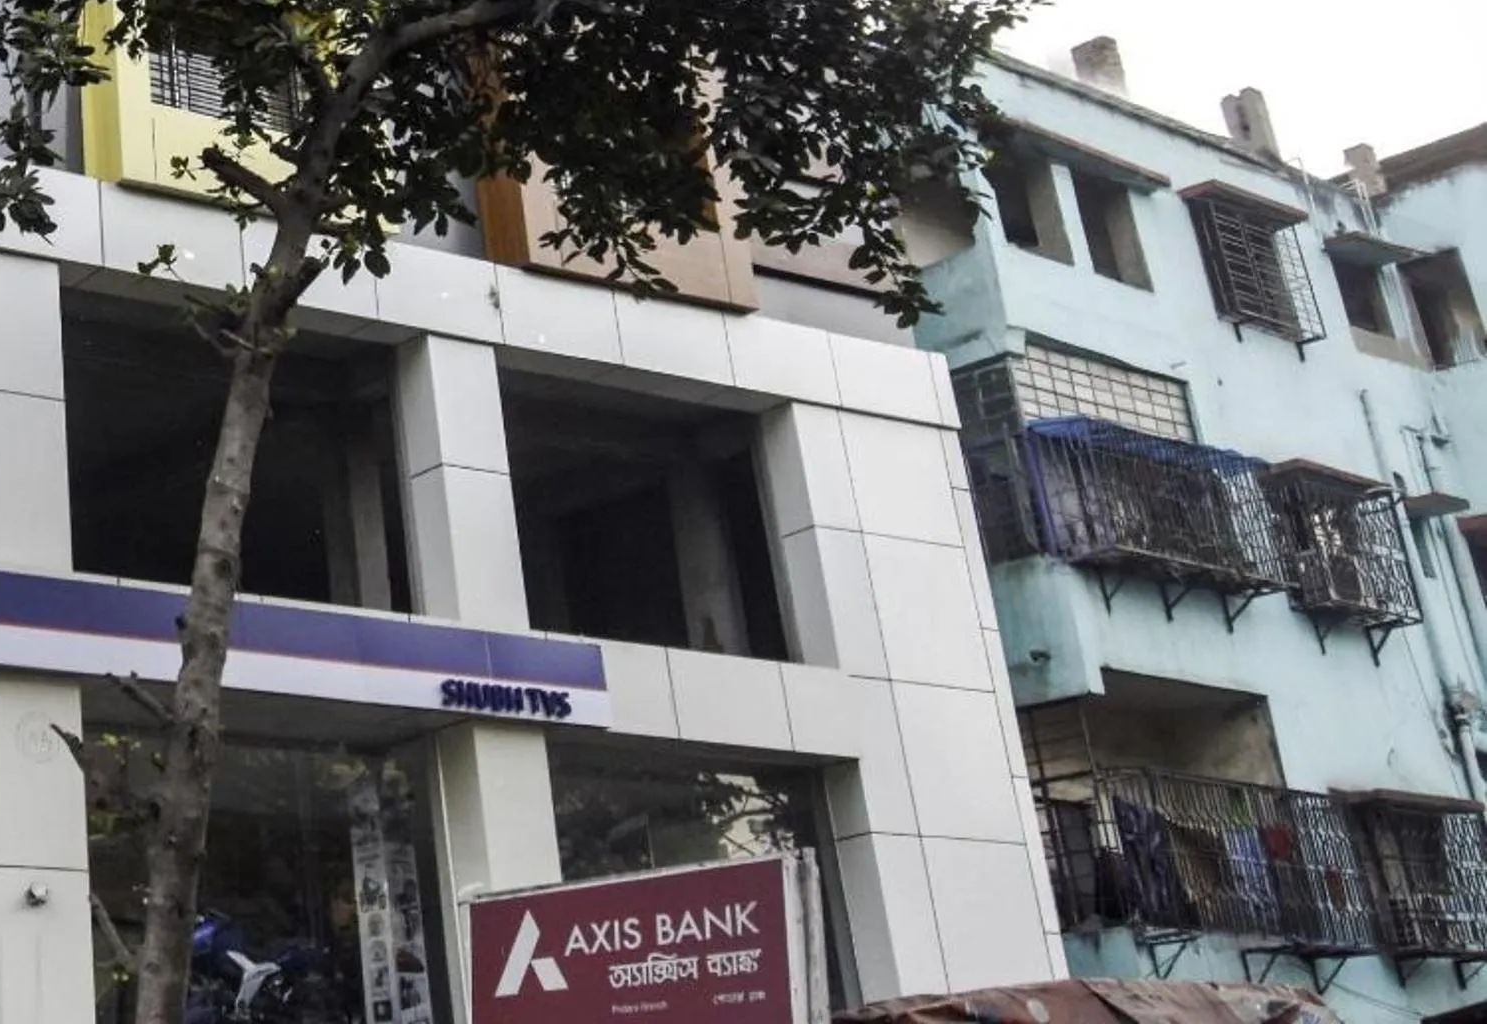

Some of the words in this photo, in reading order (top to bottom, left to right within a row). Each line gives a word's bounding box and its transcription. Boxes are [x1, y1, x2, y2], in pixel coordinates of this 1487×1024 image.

[441, 679, 523, 714] SHUBH
[525, 688, 571, 718] TVS
[564, 917, 642, 957] AXIS
[656, 901, 760, 947] BANK
